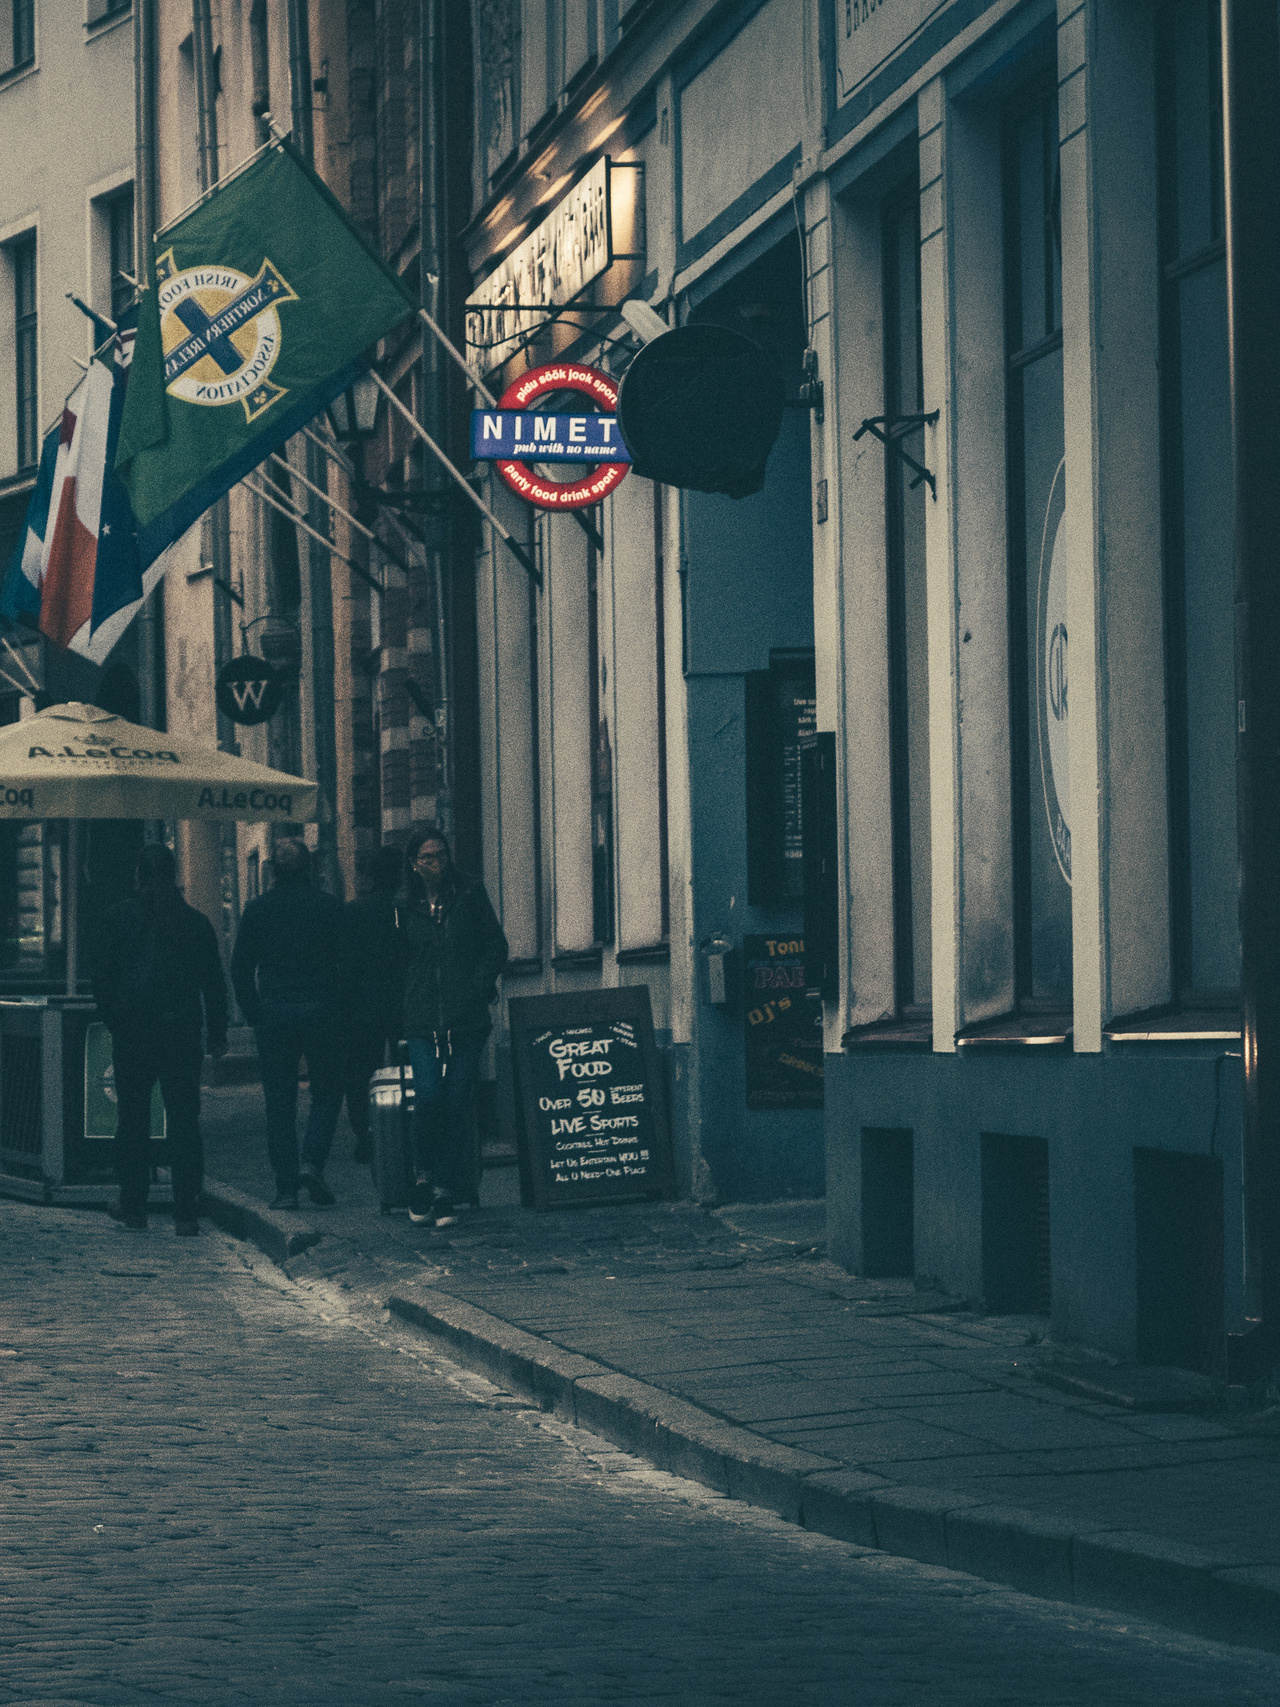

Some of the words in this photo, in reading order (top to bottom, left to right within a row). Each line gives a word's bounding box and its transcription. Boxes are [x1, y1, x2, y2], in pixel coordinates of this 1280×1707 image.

[516, 379, 539, 402] pidu
[568, 368, 593, 384] jook
[593, 379, 618, 404] sport
[513, 442, 537, 455] pub
[538, 442, 564, 455] with
[566, 444, 582, 455] no
[584, 445, 617, 456] name
[504, 464, 531, 492] party
[530, 485, 558, 503] food
[559, 487, 592, 503] drink
[591, 467, 619, 494] sport
[226, 680, 267, 711] W
[28, 745, 182, 764] A.LeCoq
[197, 786, 294, 816] A.LeCoq
[576, 1088, 606, 1108] 50
[551, 1116, 587, 1135] LIVE
